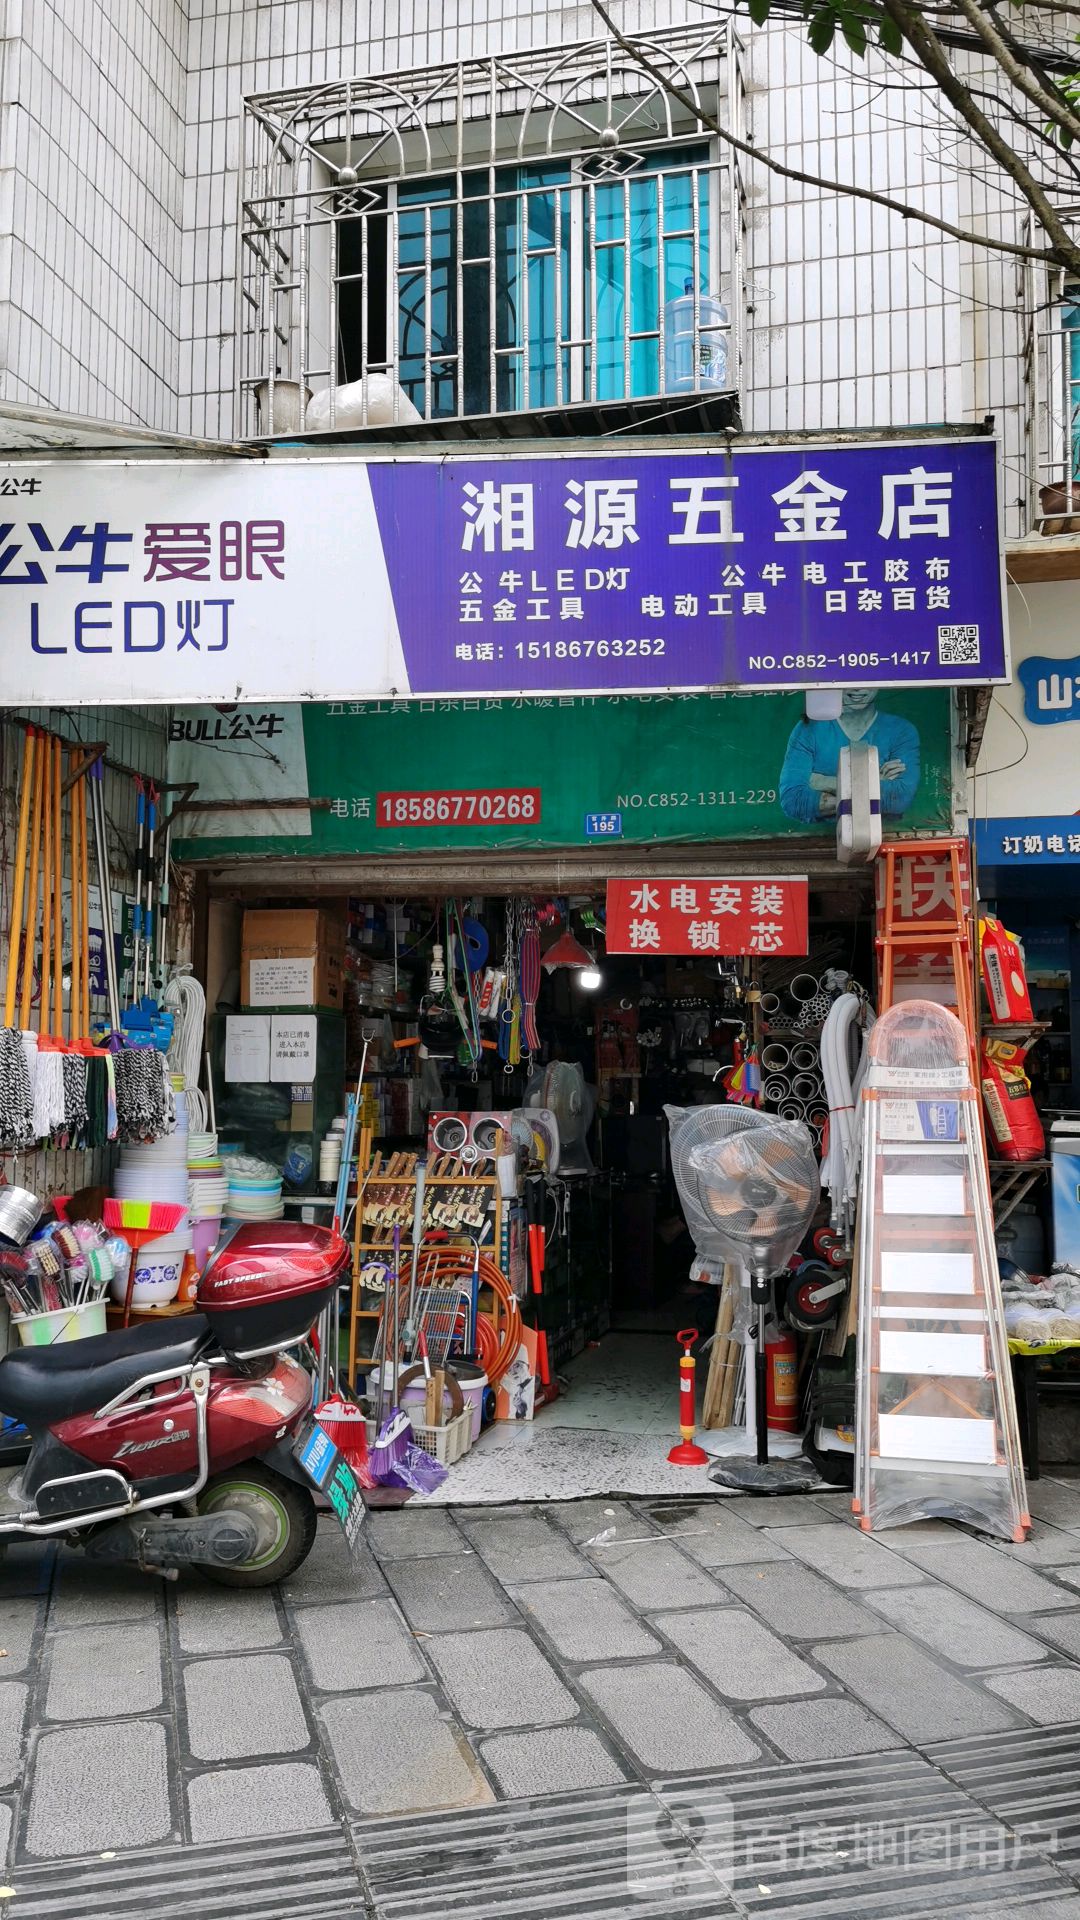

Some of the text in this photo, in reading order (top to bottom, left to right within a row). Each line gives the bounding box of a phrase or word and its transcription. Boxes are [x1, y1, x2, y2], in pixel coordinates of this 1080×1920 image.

[1, 477, 42, 496] 公牛
[461, 466, 953, 552] 湘源五金店
[0, 519, 286, 583] 公牛爱眼
[459, 556, 951, 595] 公牛LED灯 公牛电工胶布
[458, 585, 952, 623] 五金工具 电动工具 日杂百货
[30, 598, 235, 655] LED灯
[748, 650, 932, 671] NO.C852-1905-1417
[168, 713, 285, 742] BULL公牛
[329, 794, 536, 822] 电话 18586770268
[616, 789, 776, 808] NO.C852-1311-229
[592, 821, 615, 832] 195
[628, 884, 786, 917] 水电安装
[628, 919, 786, 953] 换锁芯
[279, 1041, 307, 1049] 进入本店
[214, 1277, 234, 1288] FAST
